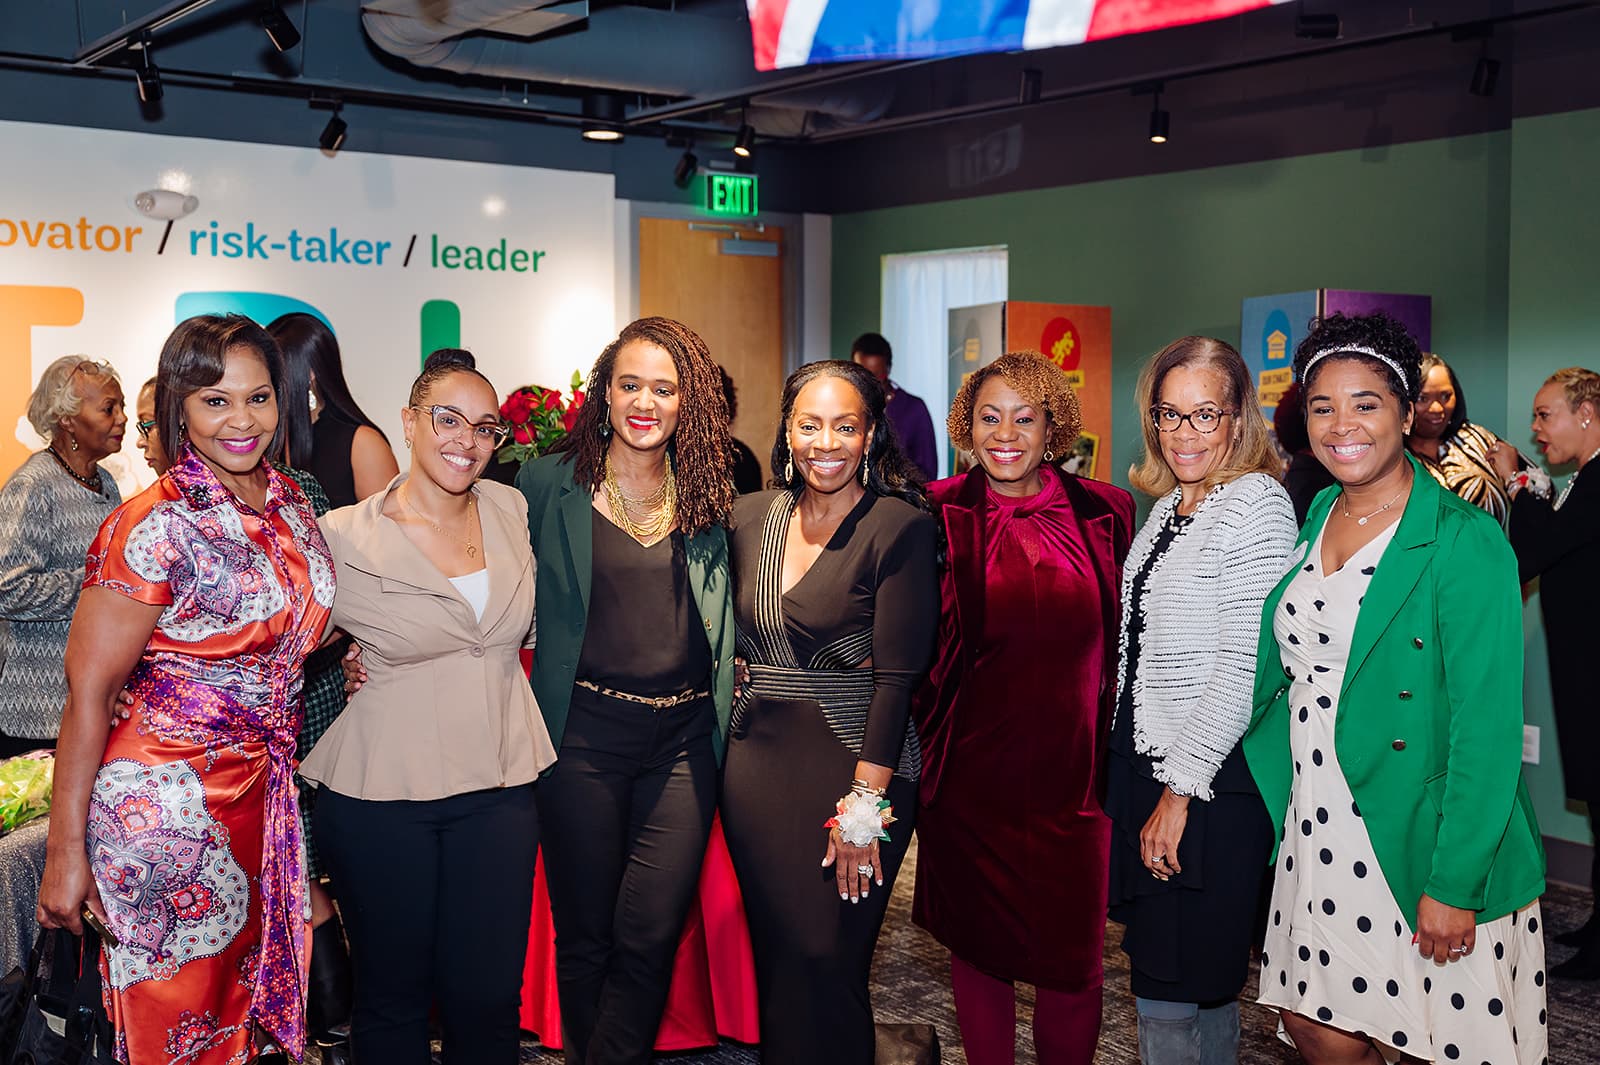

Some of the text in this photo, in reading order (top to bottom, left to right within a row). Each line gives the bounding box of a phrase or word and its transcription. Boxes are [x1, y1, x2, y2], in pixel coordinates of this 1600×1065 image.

[712, 175, 752, 214] EXIT
[189, 220, 392, 266] risk-taker
[431, 233, 546, 273] leader
